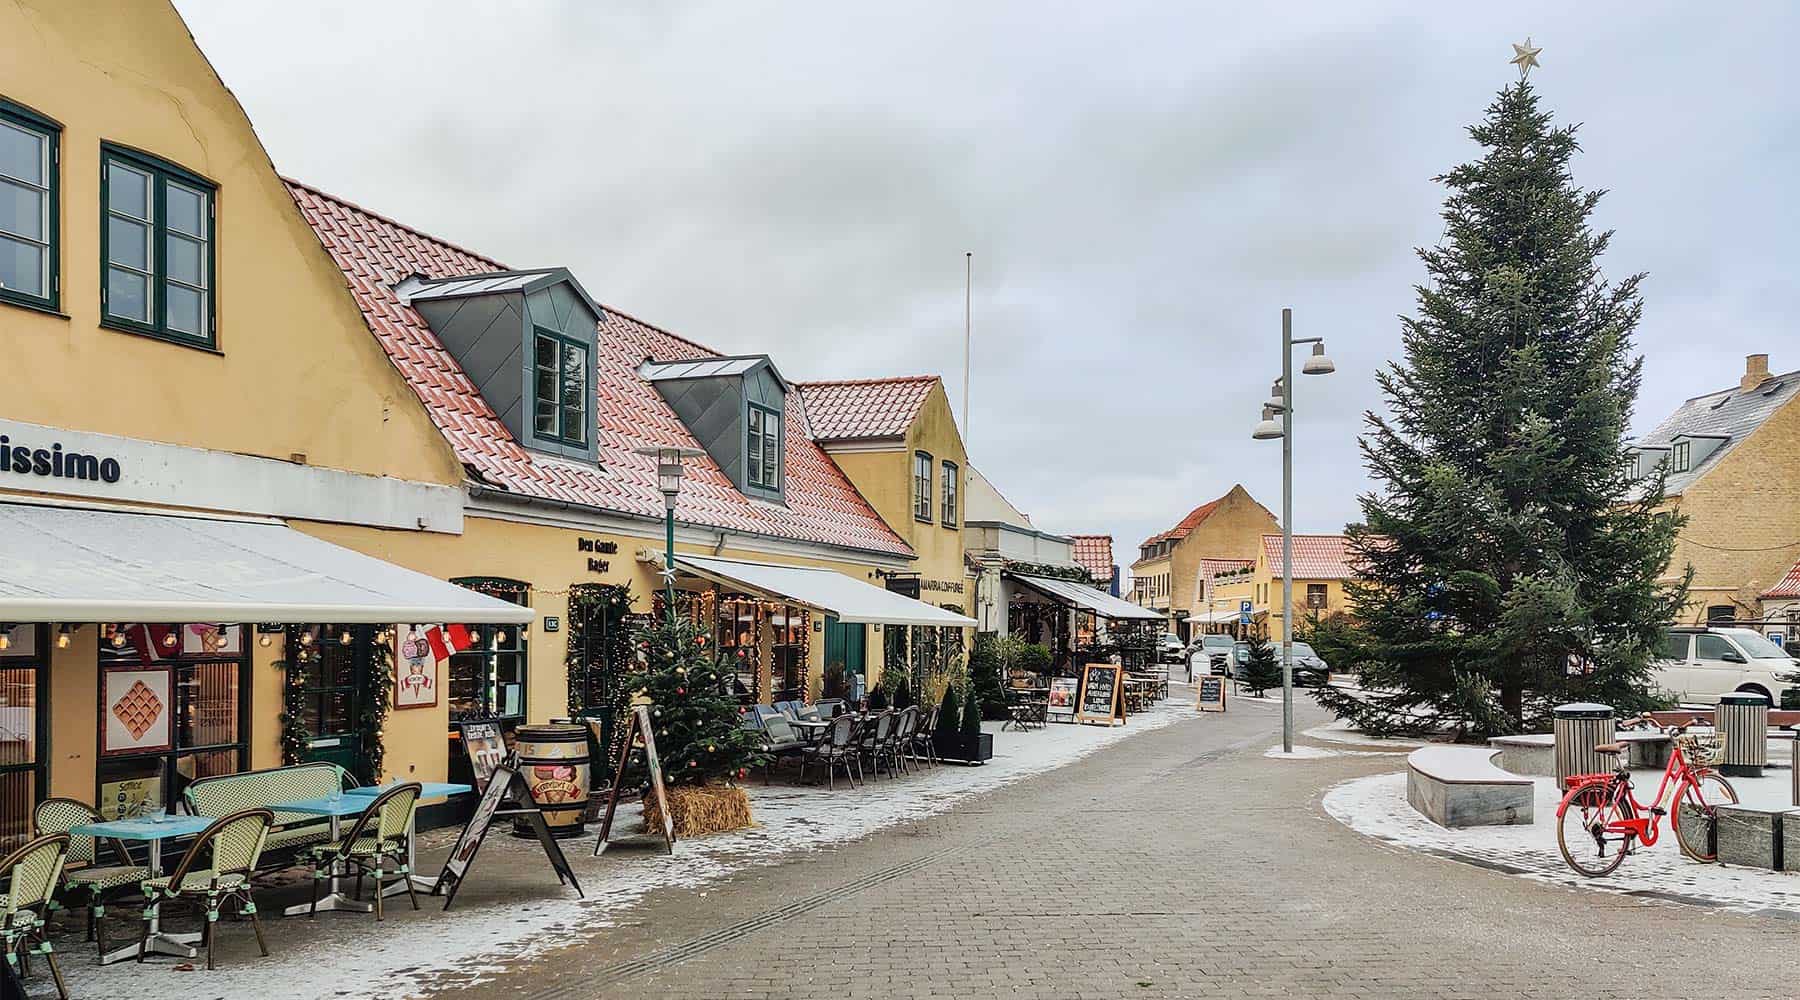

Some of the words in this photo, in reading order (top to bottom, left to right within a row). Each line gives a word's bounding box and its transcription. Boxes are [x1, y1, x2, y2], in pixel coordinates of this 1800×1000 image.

[0, 434, 121, 484] issimo
[578, 537, 593, 552] Den
[587, 557, 610, 574] Bager
[1243, 602, 1250, 611] P
